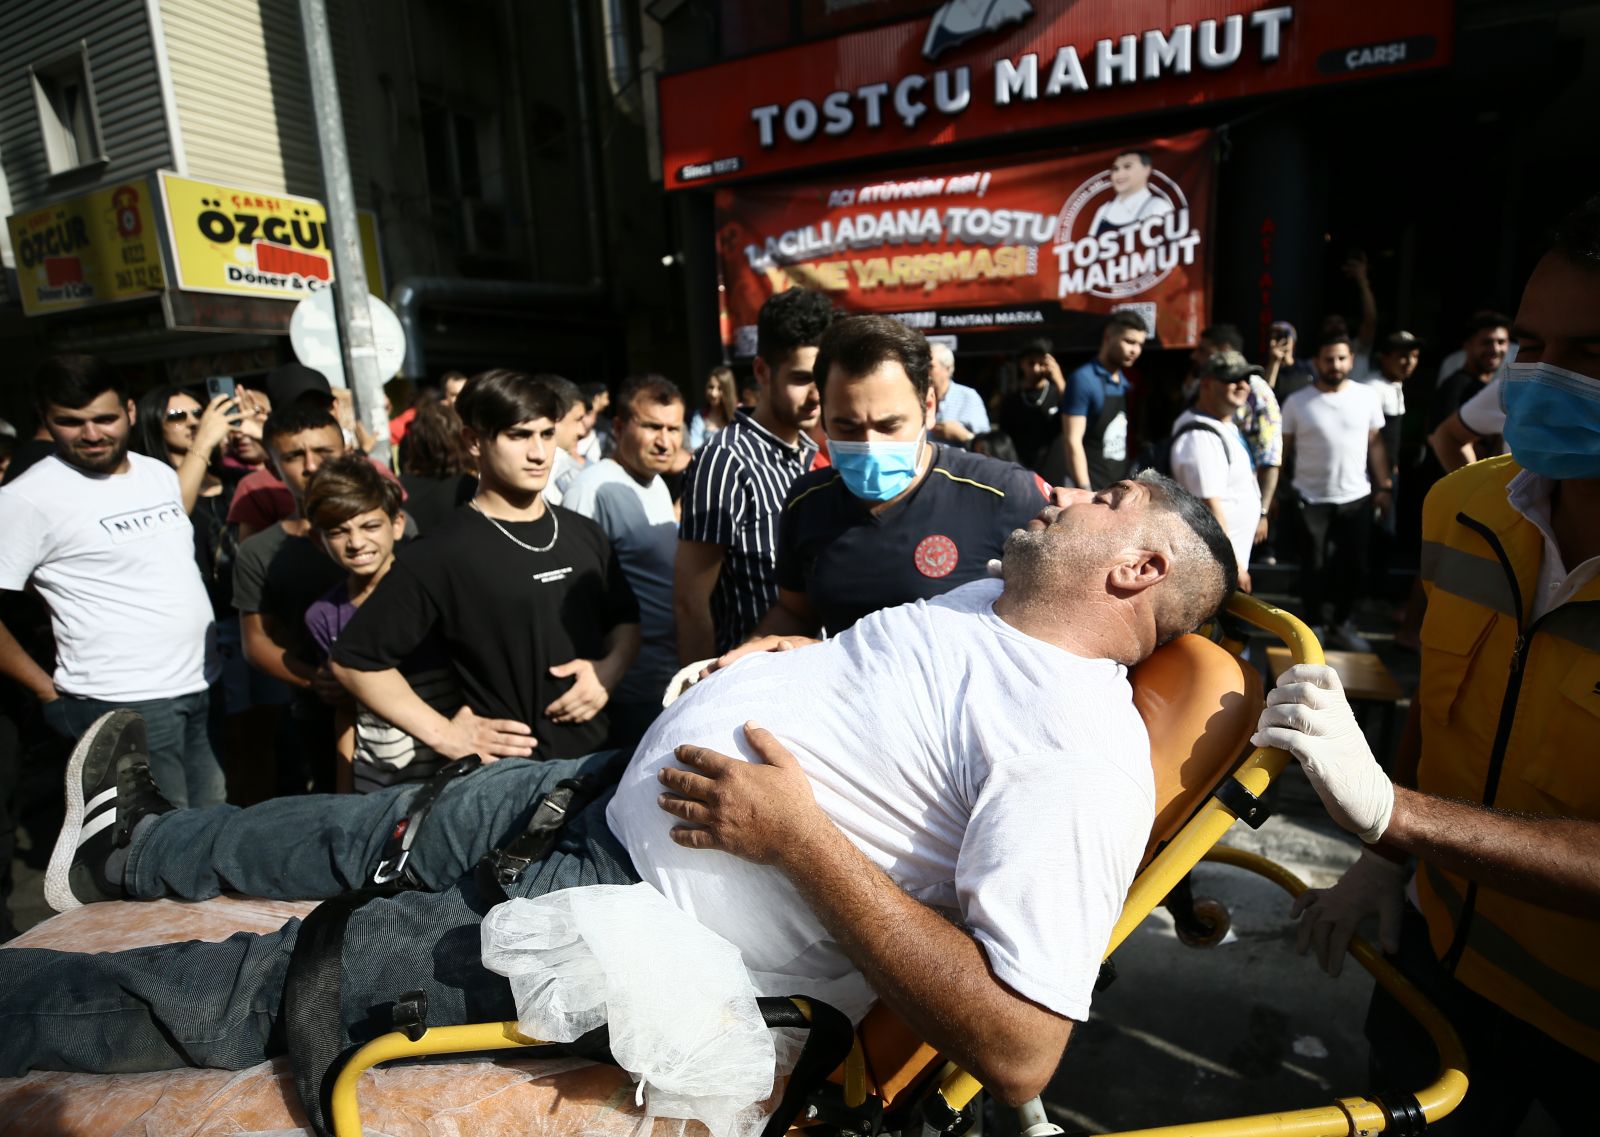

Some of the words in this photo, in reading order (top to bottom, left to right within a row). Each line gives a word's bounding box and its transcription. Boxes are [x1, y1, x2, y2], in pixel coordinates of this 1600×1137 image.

[751, 66, 971, 147] TOSTÇU
[994, 5, 1293, 104] MAHMUT
[1345, 43, 1407, 70] ÇARŞI
[197, 198, 332, 250] ÖZGÜ
[230, 195, 281, 213] ÇARŞI
[835, 207, 942, 246] ADANA
[946, 207, 1058, 244] TOSTU
[228, 267, 288, 288] Döner
[291, 278, 303, 289] &
[850, 246, 1029, 292] YARIŞMASI
[1058, 234, 1201, 299] MAHMUT
